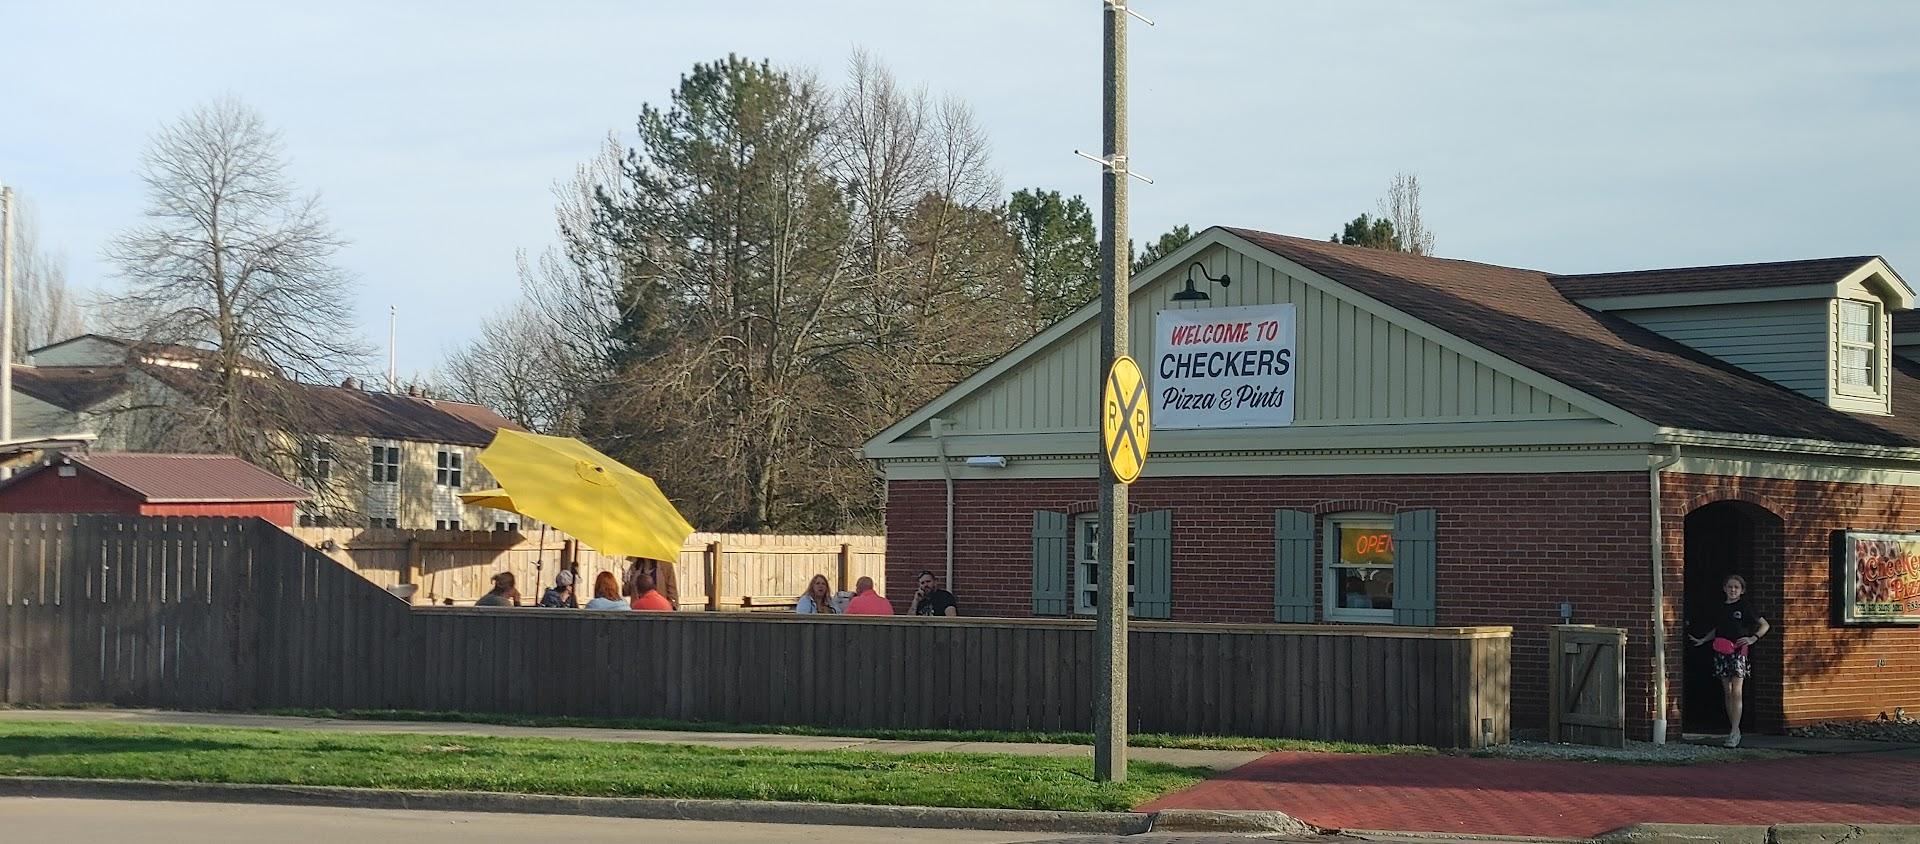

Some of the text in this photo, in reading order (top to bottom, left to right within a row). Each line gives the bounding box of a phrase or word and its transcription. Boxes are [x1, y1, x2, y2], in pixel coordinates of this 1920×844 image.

[1171, 320, 1279, 346] WELCOME TO
[1159, 348, 1291, 380] CHECKERS
[1162, 384, 1285, 411] Pizza & Pints
[1865, 552, 1920, 581] Checke
